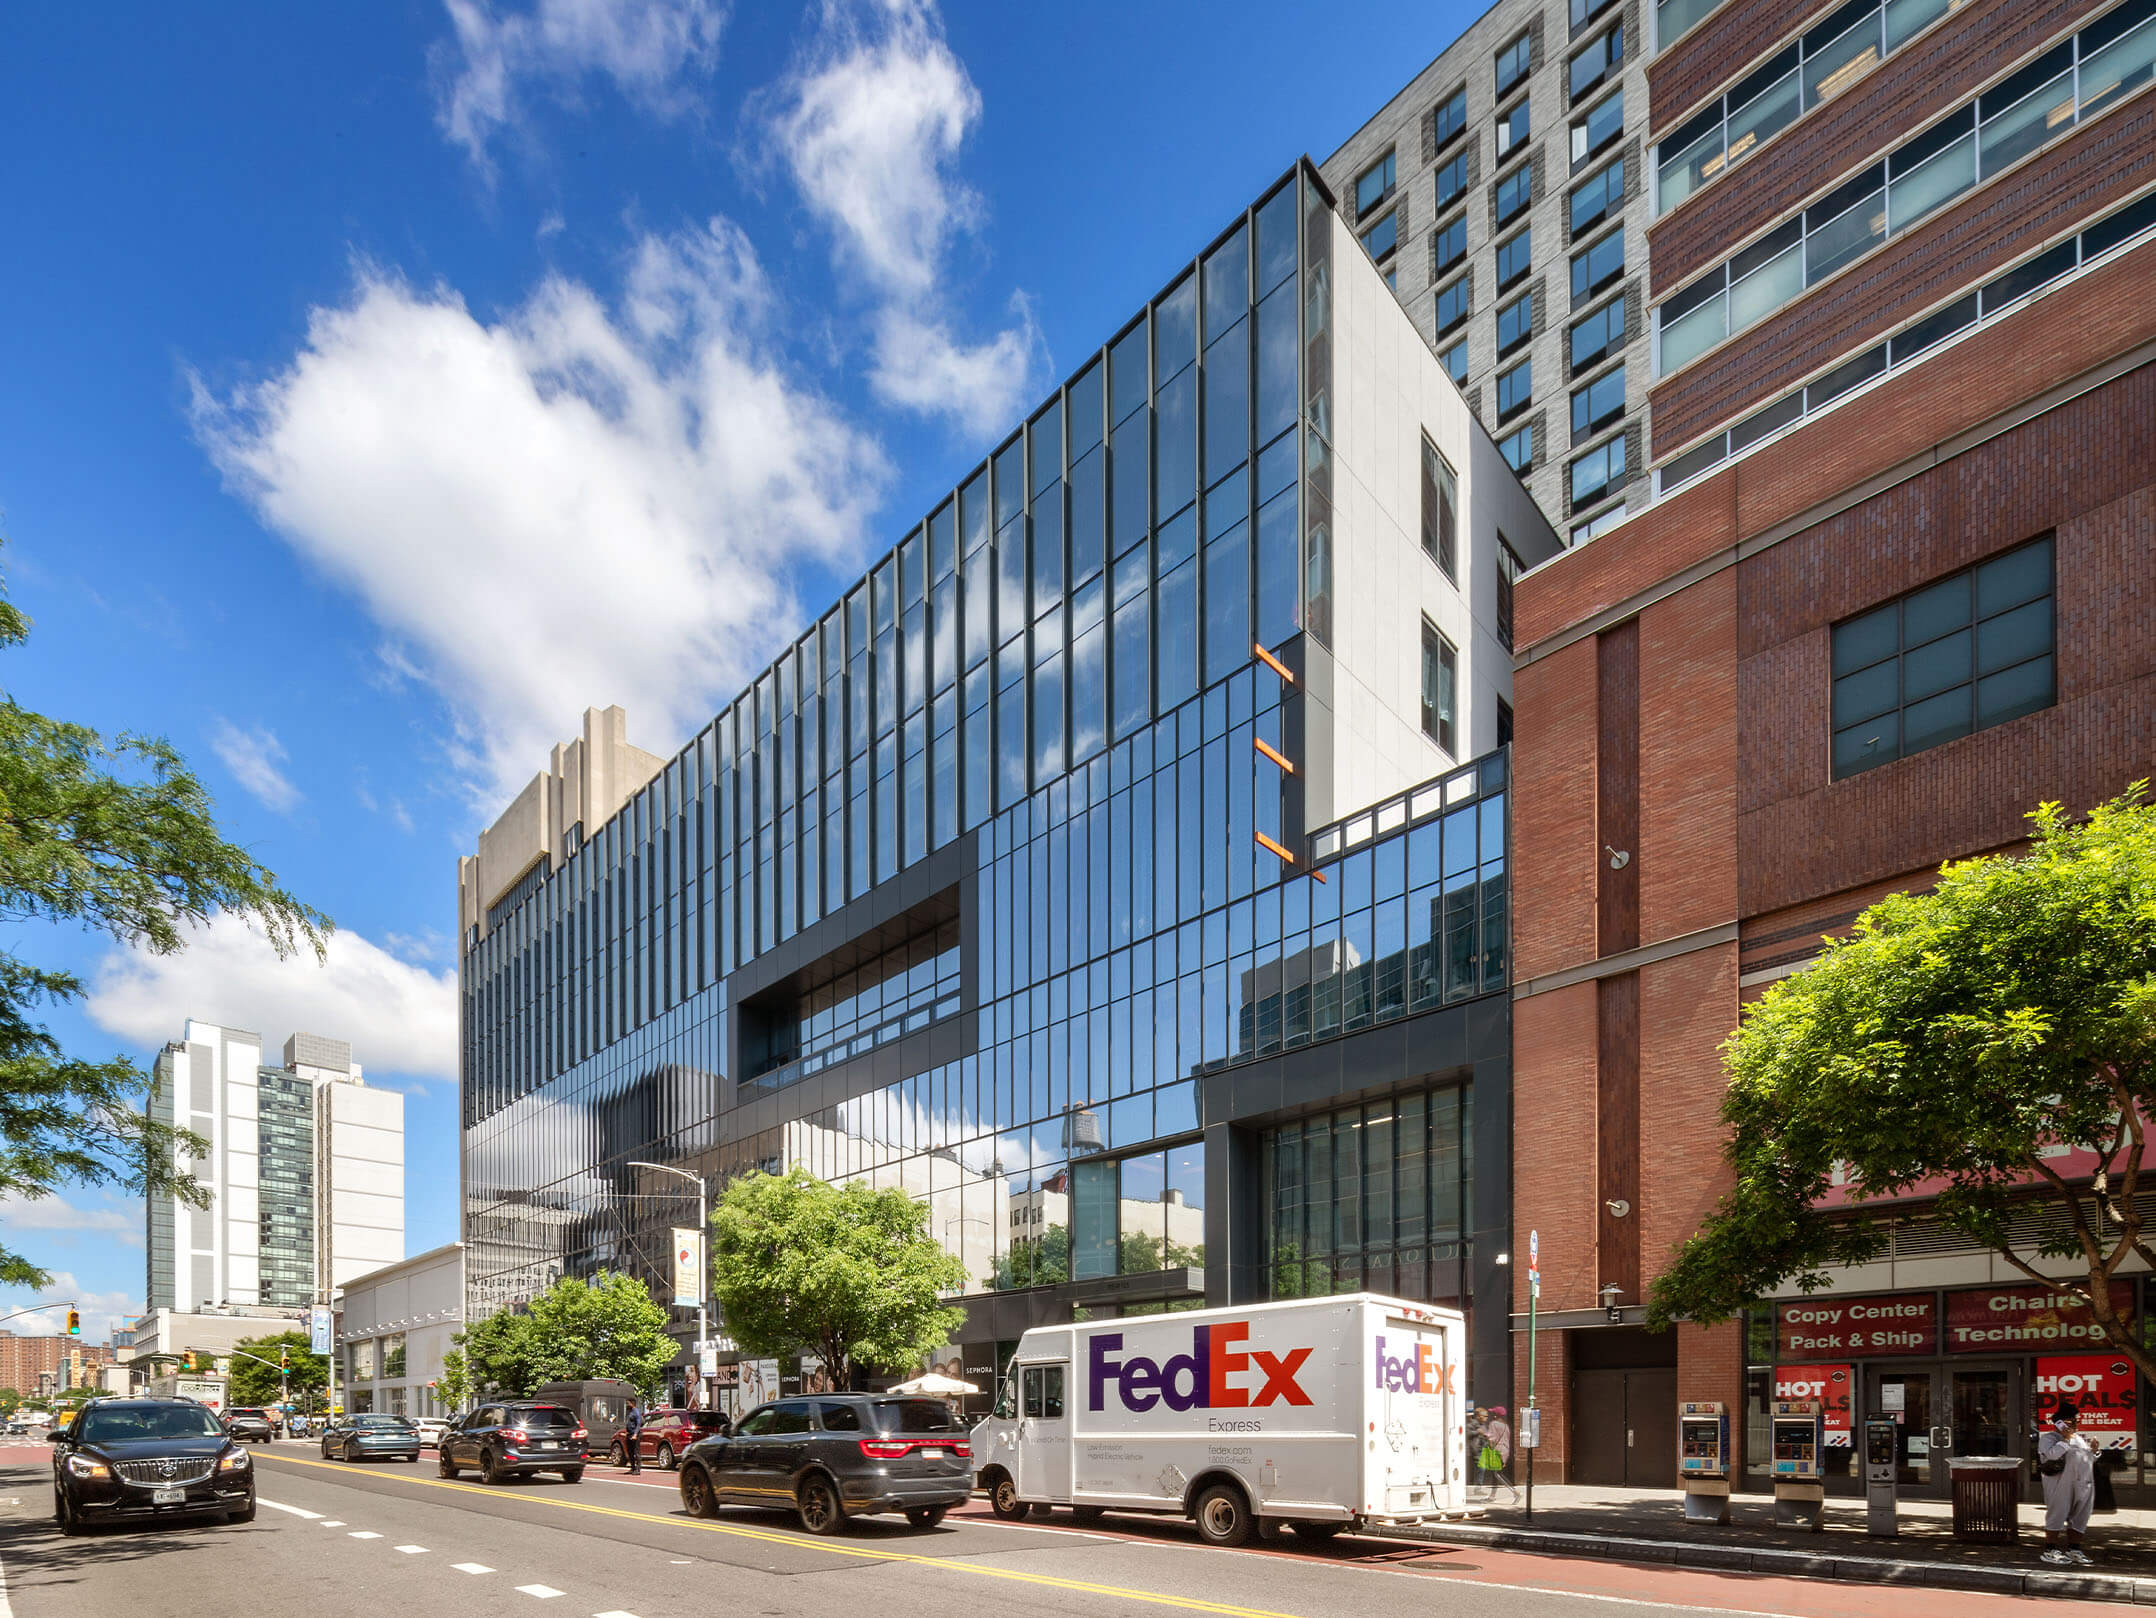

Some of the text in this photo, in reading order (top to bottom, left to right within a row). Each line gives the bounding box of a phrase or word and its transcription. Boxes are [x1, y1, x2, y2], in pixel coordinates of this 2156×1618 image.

[1988, 1293, 2086, 1312] Chairs
[1785, 1309, 1842, 1325] Copy
[1849, 1303, 1929, 1320] Center
[1790, 1331, 1924, 1350] Pack & Ship
[1953, 1323, 2107, 1342] Technolog
[966, 1366, 993, 1375] SEPHORA
[1089, 1321, 1315, 1412] FedEx
[1375, 1335, 1456, 1395] FedEx
[1775, 1381, 1826, 1397] HOT
[2037, 1374, 2103, 1393] HOT
[1209, 1417, 1262, 1432] Express
[1208, 1444, 1253, 1456] fedex.com
